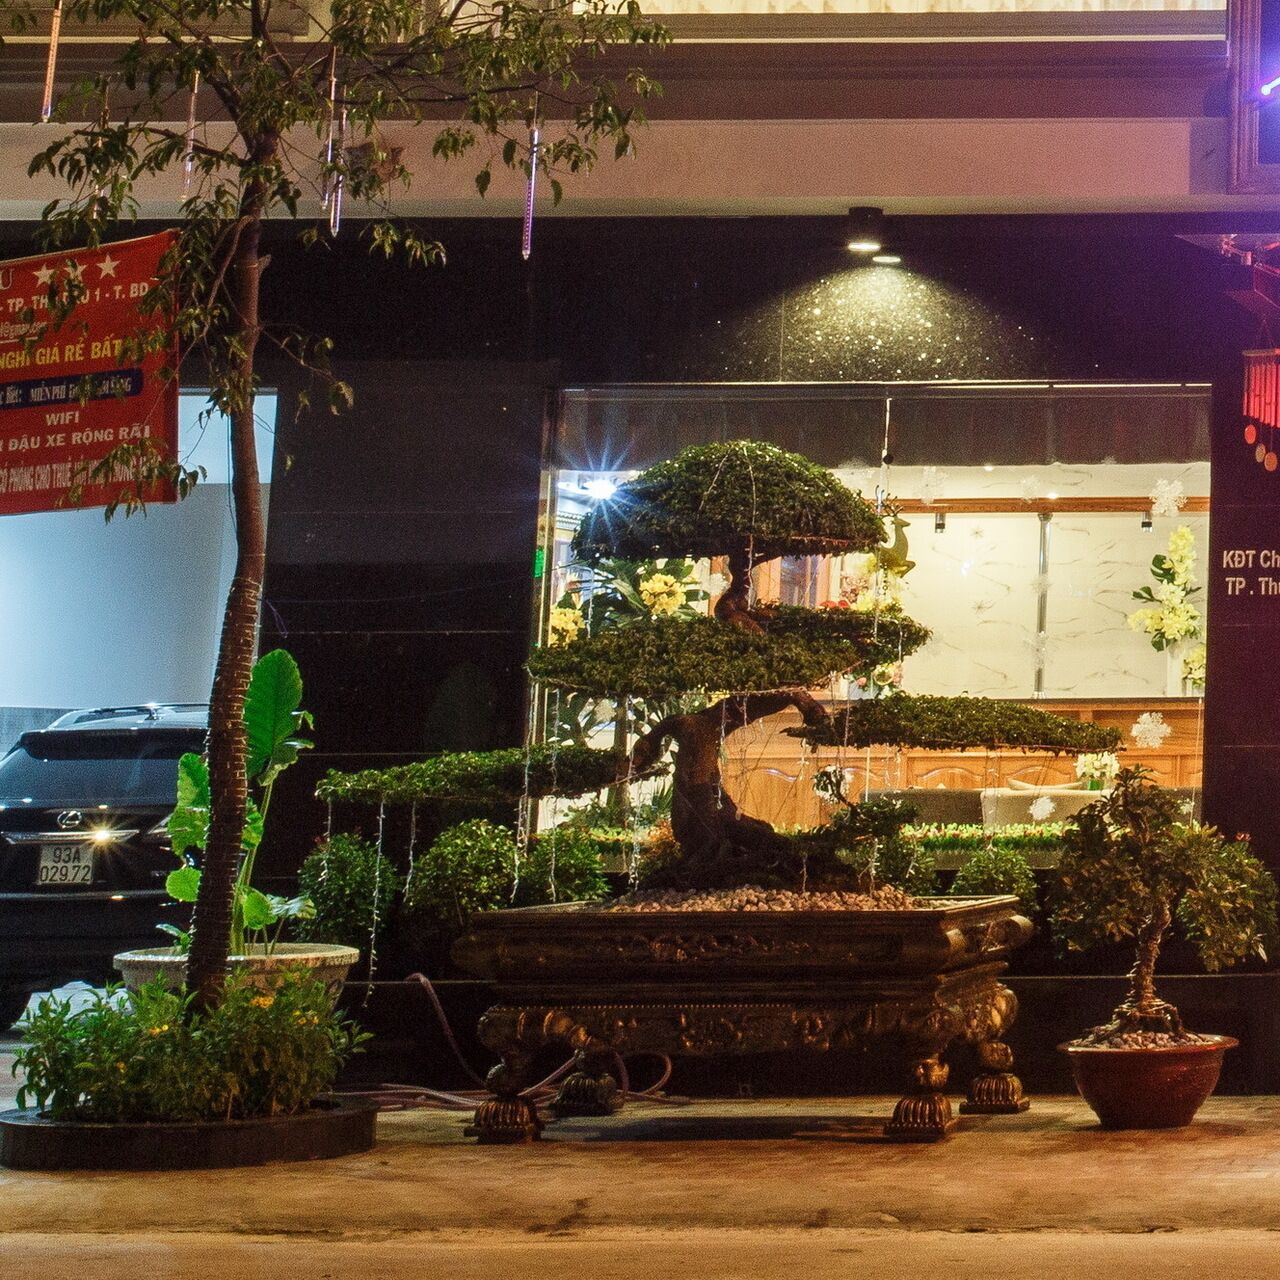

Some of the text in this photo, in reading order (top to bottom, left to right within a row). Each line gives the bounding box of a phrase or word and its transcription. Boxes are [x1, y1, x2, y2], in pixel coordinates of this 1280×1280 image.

[130, 282, 149, 298] BD
[36, 342, 60, 365] GIÁ
[46, 411, 79, 427] WIFI
[46, 433, 65, 447] XE
[72, 428, 114, 445] RỘNG
[1223, 550, 1256, 568] KĐT
[53, 846, 81, 864] 93A
